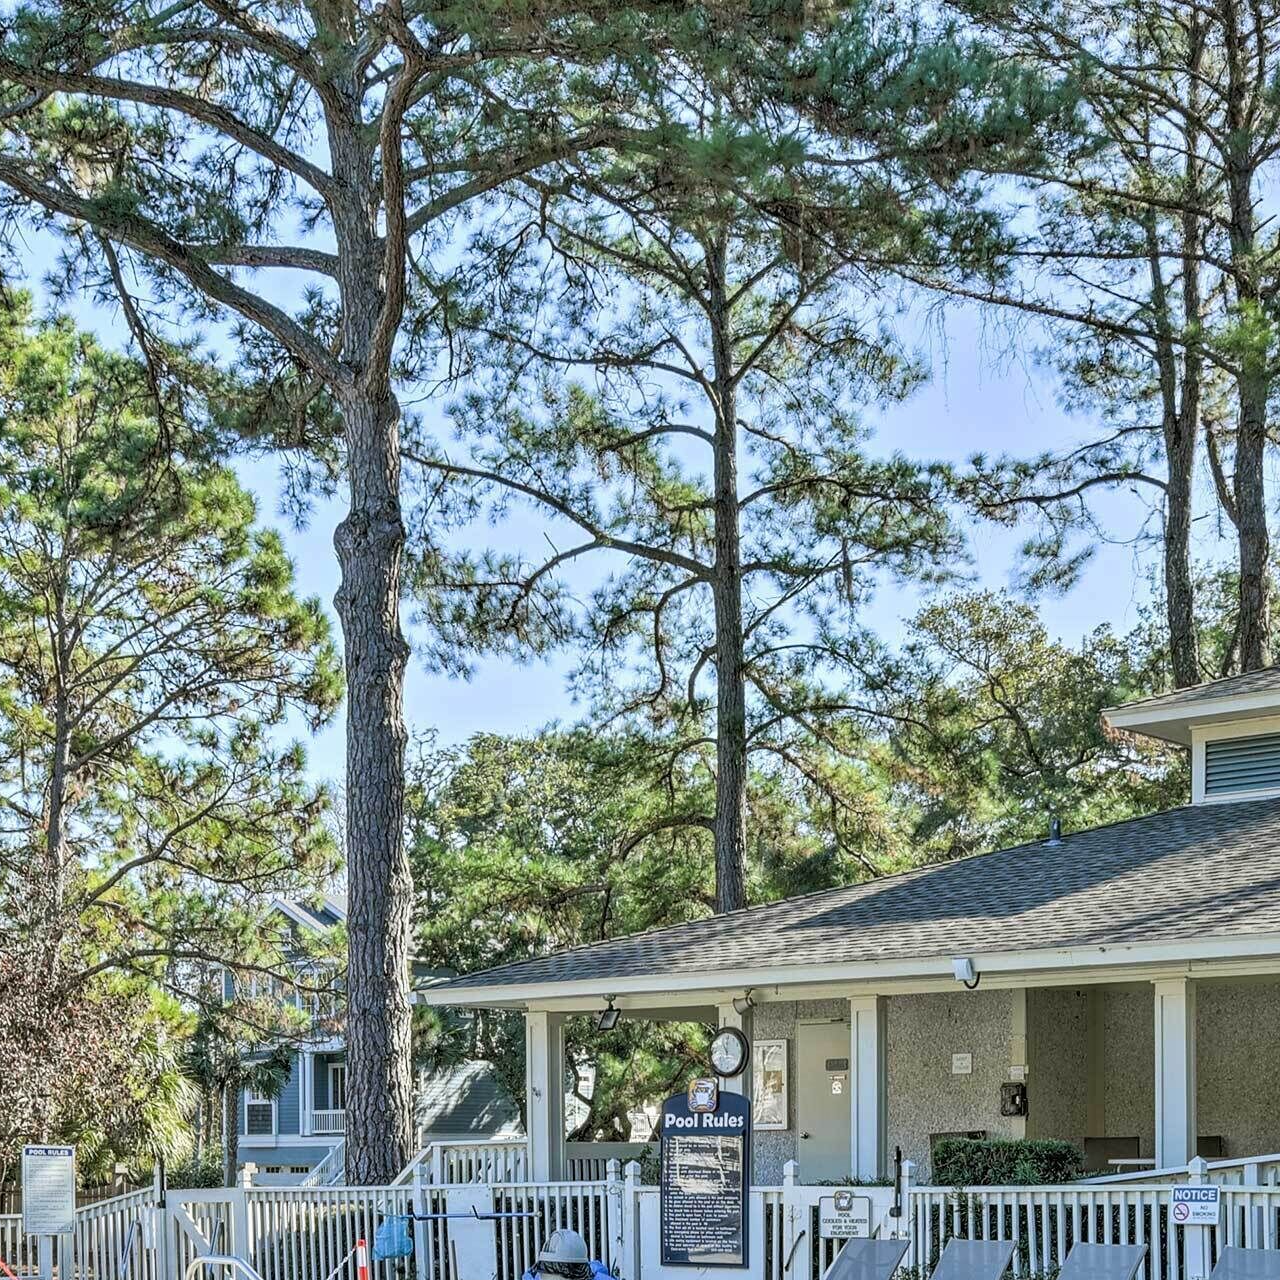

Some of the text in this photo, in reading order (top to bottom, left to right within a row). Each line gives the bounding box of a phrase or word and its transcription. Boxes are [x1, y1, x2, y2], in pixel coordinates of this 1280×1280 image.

[664, 1112, 744, 1128] Pool Rules
[1174, 1190, 1216, 1200] NOTICE
